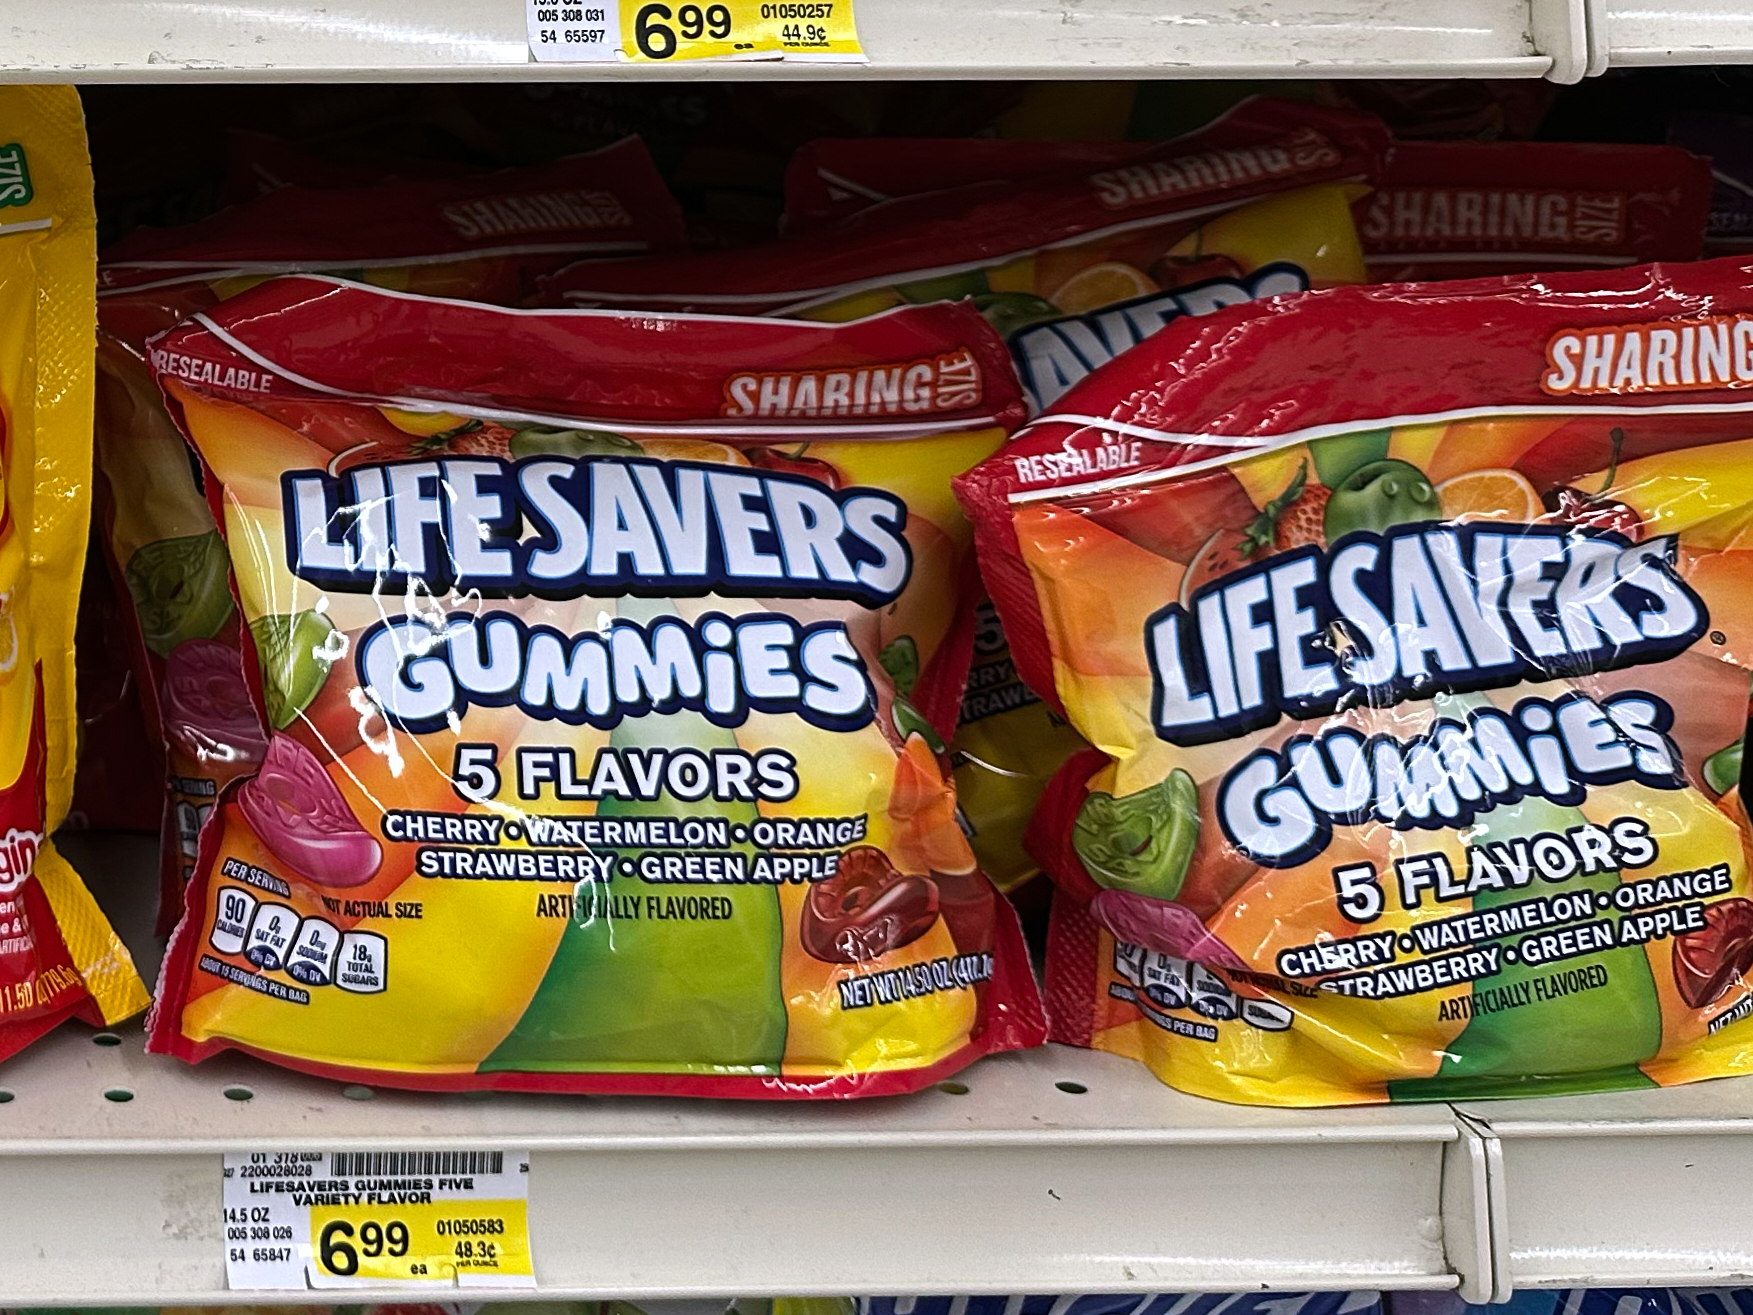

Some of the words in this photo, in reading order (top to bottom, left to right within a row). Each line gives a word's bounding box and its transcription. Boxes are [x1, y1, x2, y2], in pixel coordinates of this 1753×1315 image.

[761, 4, 833, 19] 01050257
[782, 25, 826, 41] 44.9¢
[1091, 149, 1289, 207] SHARING
[1366, 192, 1571, 240] SHARING
[156, 349, 273, 394] RESEALABLE
[725, 364, 933, 417] SHARING
[939, 348, 978, 408] SIZE
[1014, 440, 1142, 484] RESEALABLE
[457, 749, 497, 799] 5
[522, 749, 797, 800] FLAVORS
[385, 814, 502, 845] CHERRY
[522, 816, 728, 846] WATERMELON
[753, 815, 866, 846] ORANGE
[419, 851, 617, 879] STRAWBERRY
[640, 853, 747, 882] GREEN
[754, 853, 838, 882] APPLE
[1337, 866, 1383, 921] 5
[1400, 825, 1657, 907] FLAVORS
[344, 903, 392, 918] ACTUAL
[395, 902, 423, 919] SIZE
[536, 894, 642, 919] ARTIFICIALLY
[646, 896, 732, 920] FLAVORED
[1281, 935, 1394, 976] CHERRY
[1416, 894, 1592, 949] WATERMELON
[1615, 873, 1730, 909] ORANGE
[1521, 927, 1611, 961] GREEN
[1621, 909, 1703, 942] APPLE
[1438, 986, 1532, 1022] ARTIFICIALLY
[1535, 964, 1607, 1001] FLAVORED
[241, 1165, 312, 1178] 2200028028
[250, 1181, 350, 1193] LIFESAVERS
[355, 1179, 433, 1192] GUMMIES
[438, 1179, 473, 1190] FIVE
[223, 1208, 248, 1223] 14.5
[251, 1208, 269, 1222] OZ
[292, 1193, 361, 1206] VARIETY
[367, 1192, 431, 1205] FLAVOR
[437, 1219, 504, 1236] 01050583
